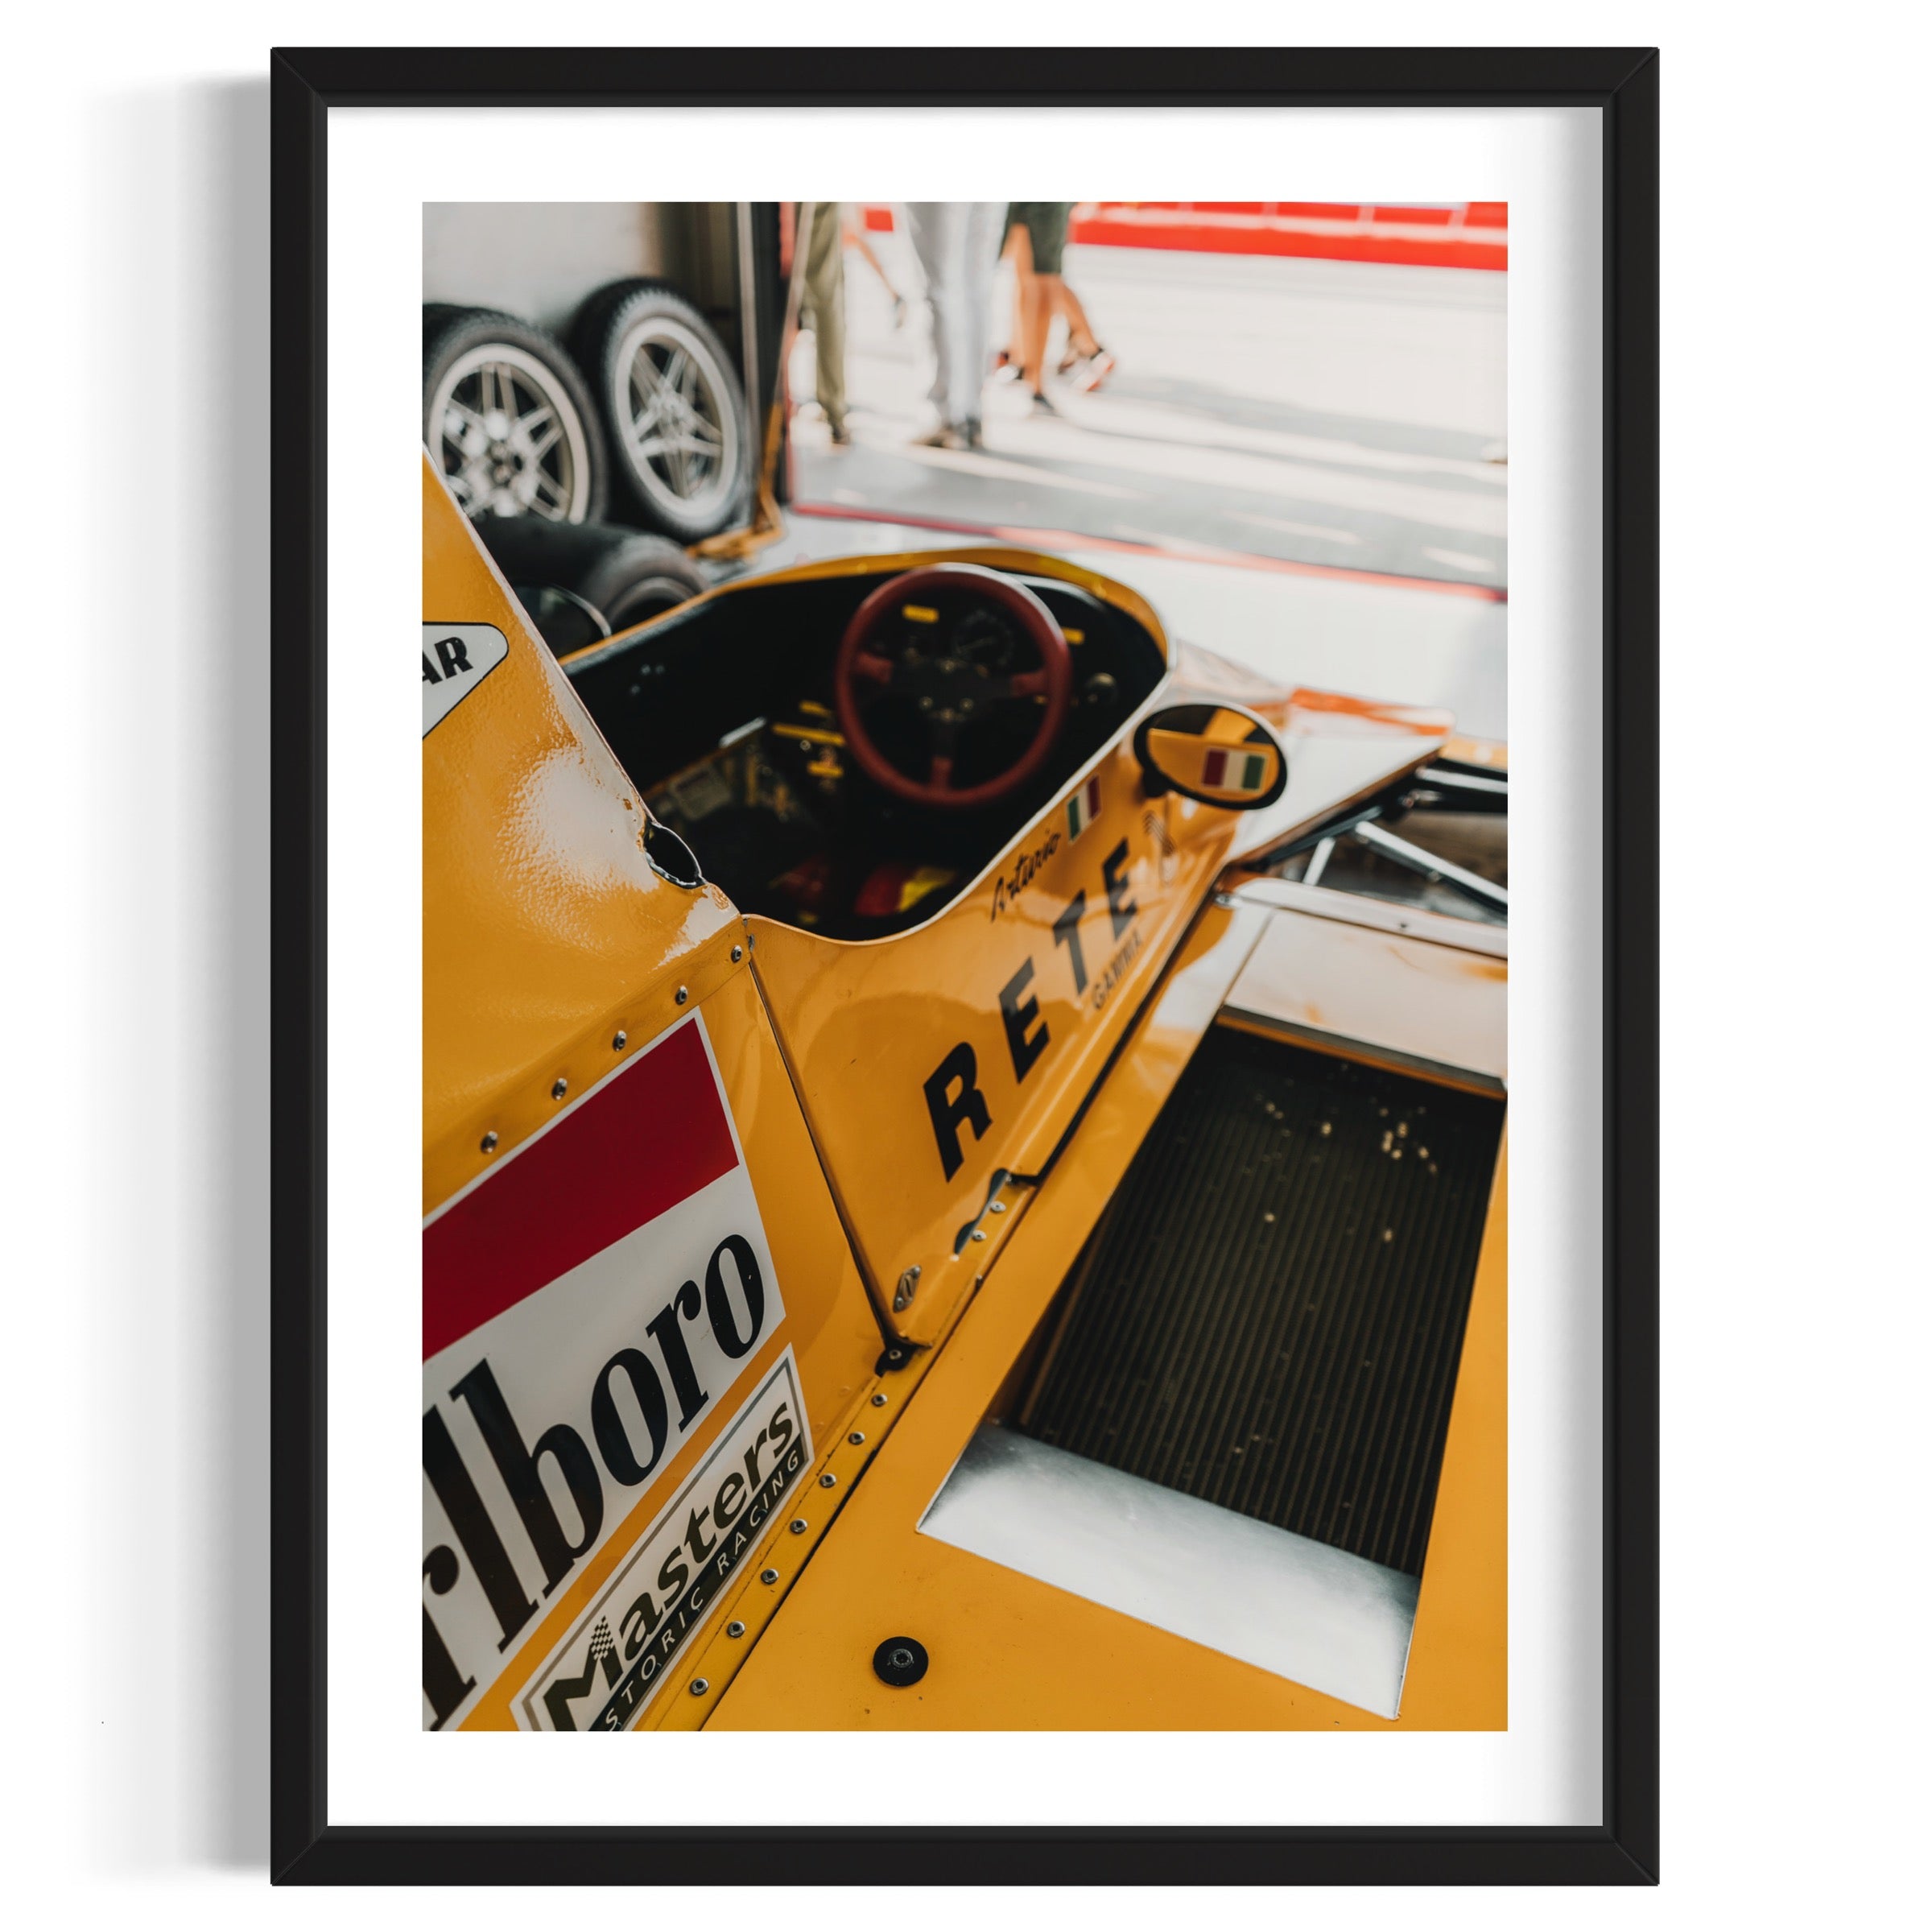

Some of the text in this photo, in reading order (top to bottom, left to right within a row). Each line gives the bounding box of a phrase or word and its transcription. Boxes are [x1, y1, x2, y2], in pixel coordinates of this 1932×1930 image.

[923, 837, 1138, 1184] RETE
[423, 1234, 764, 1731] rlboro
[543, 1402, 792, 1731] Masters
[605, 1449, 799, 1731] STORIC RACING
